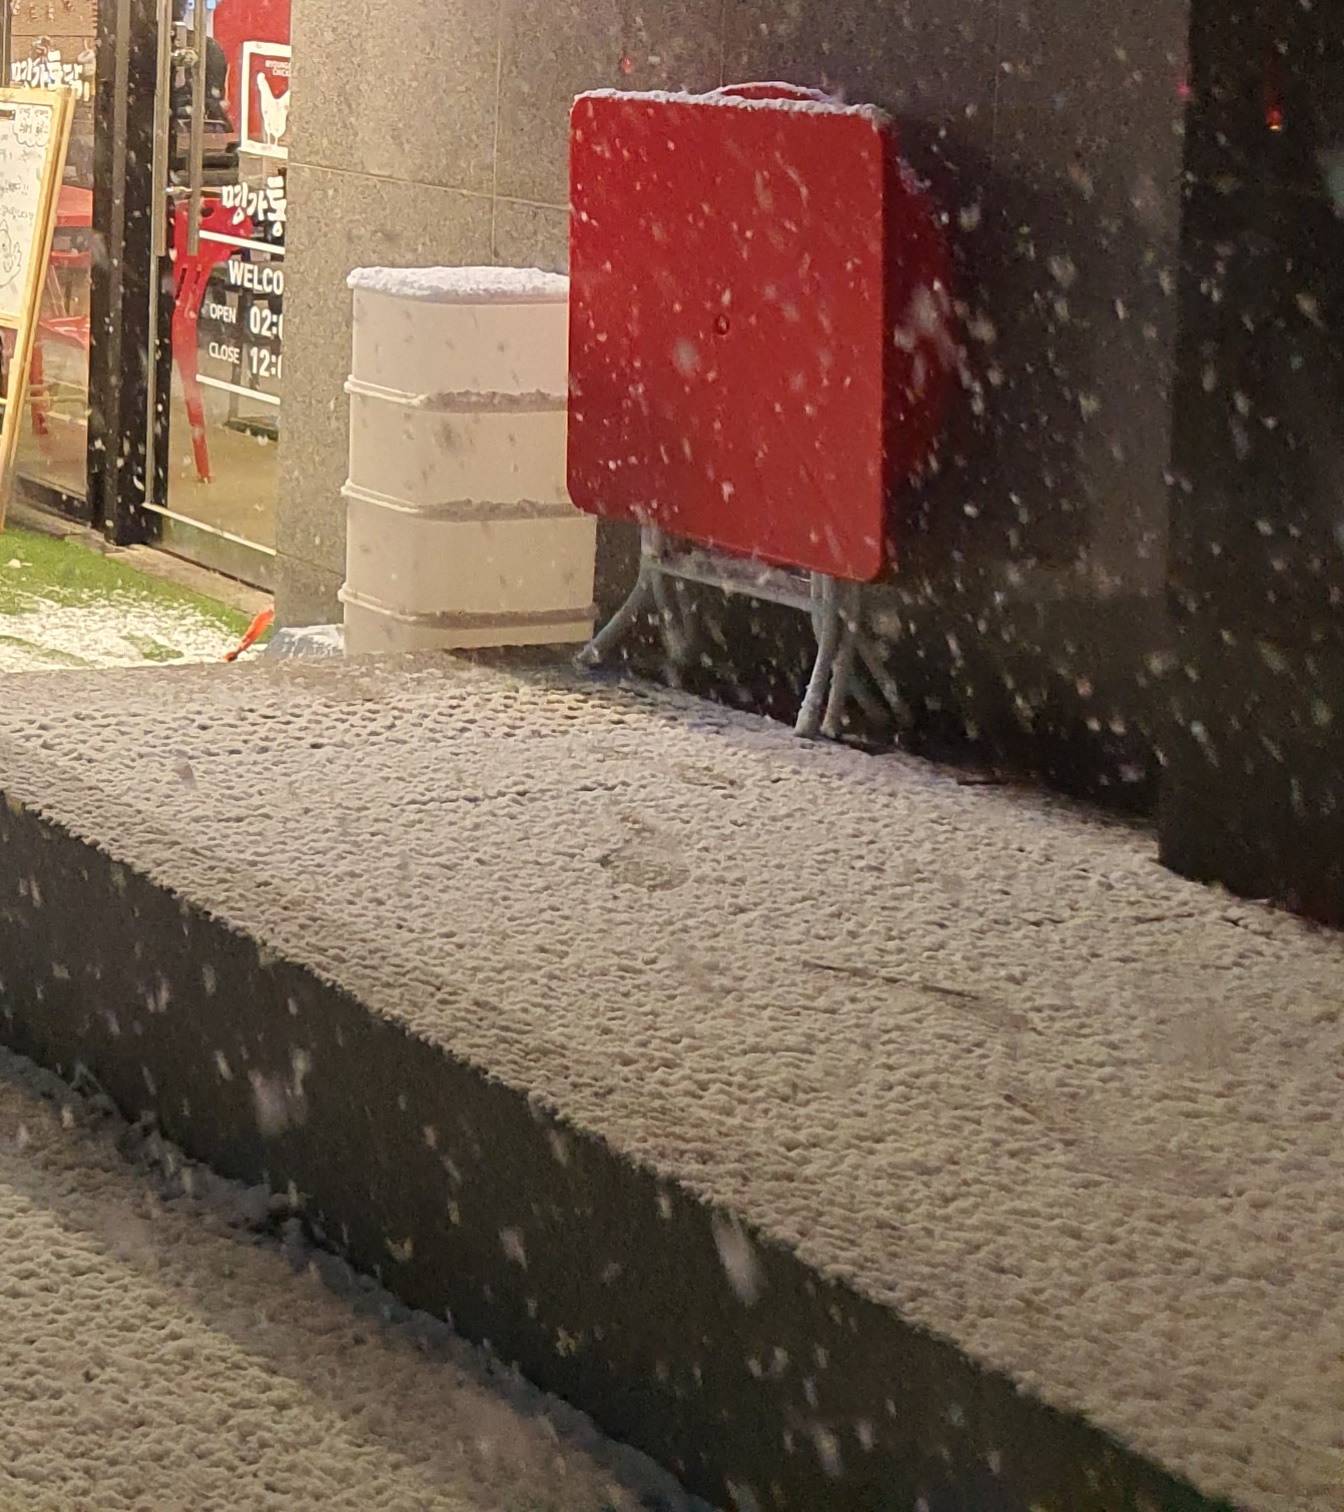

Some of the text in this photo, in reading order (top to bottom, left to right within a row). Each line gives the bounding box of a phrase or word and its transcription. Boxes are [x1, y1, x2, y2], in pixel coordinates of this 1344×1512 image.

[210, 304, 283, 340] OPEN 02:
[209, 342, 282, 380] CLOSE 12:
